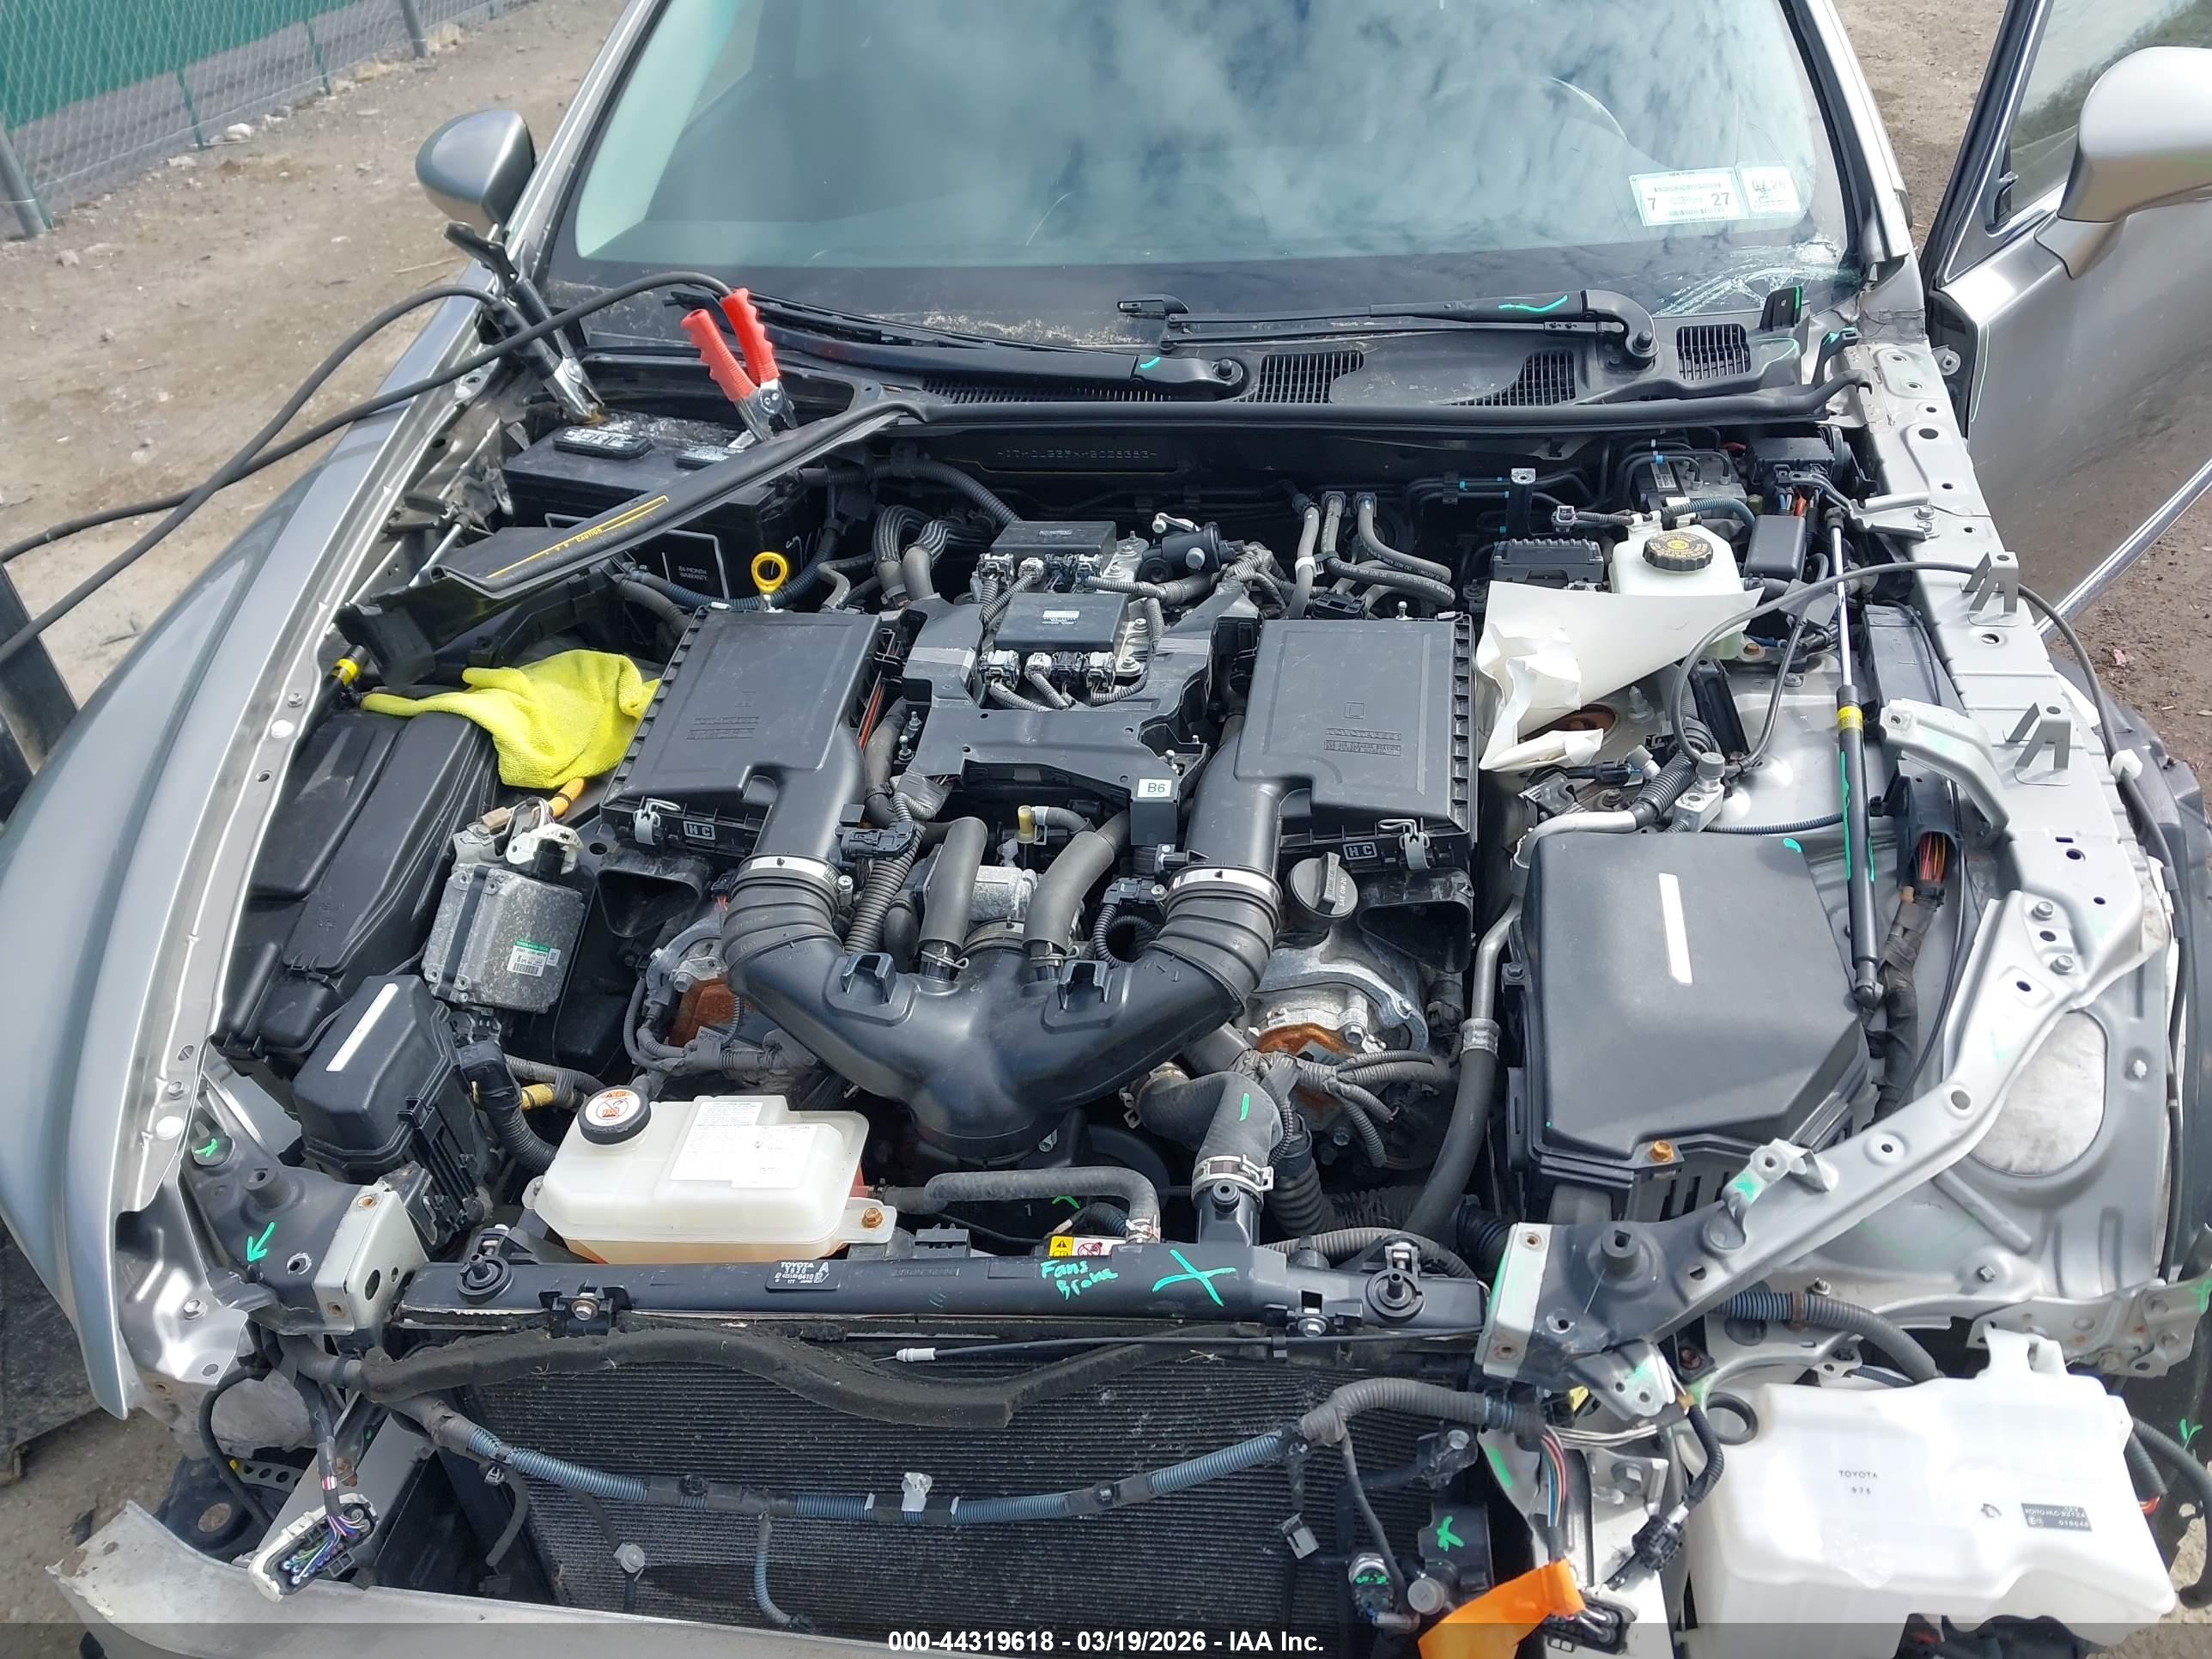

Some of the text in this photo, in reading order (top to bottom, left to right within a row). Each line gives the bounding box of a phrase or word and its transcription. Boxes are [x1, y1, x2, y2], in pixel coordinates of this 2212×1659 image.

[1647, 198, 1656, 210] 7
[1711, 191, 1730, 207] 27
[576, 527, 603, 543] CAUTION
[1147, 782, 1166, 793] B6
[1838, 1469, 1879, 1479] TOYOTA
